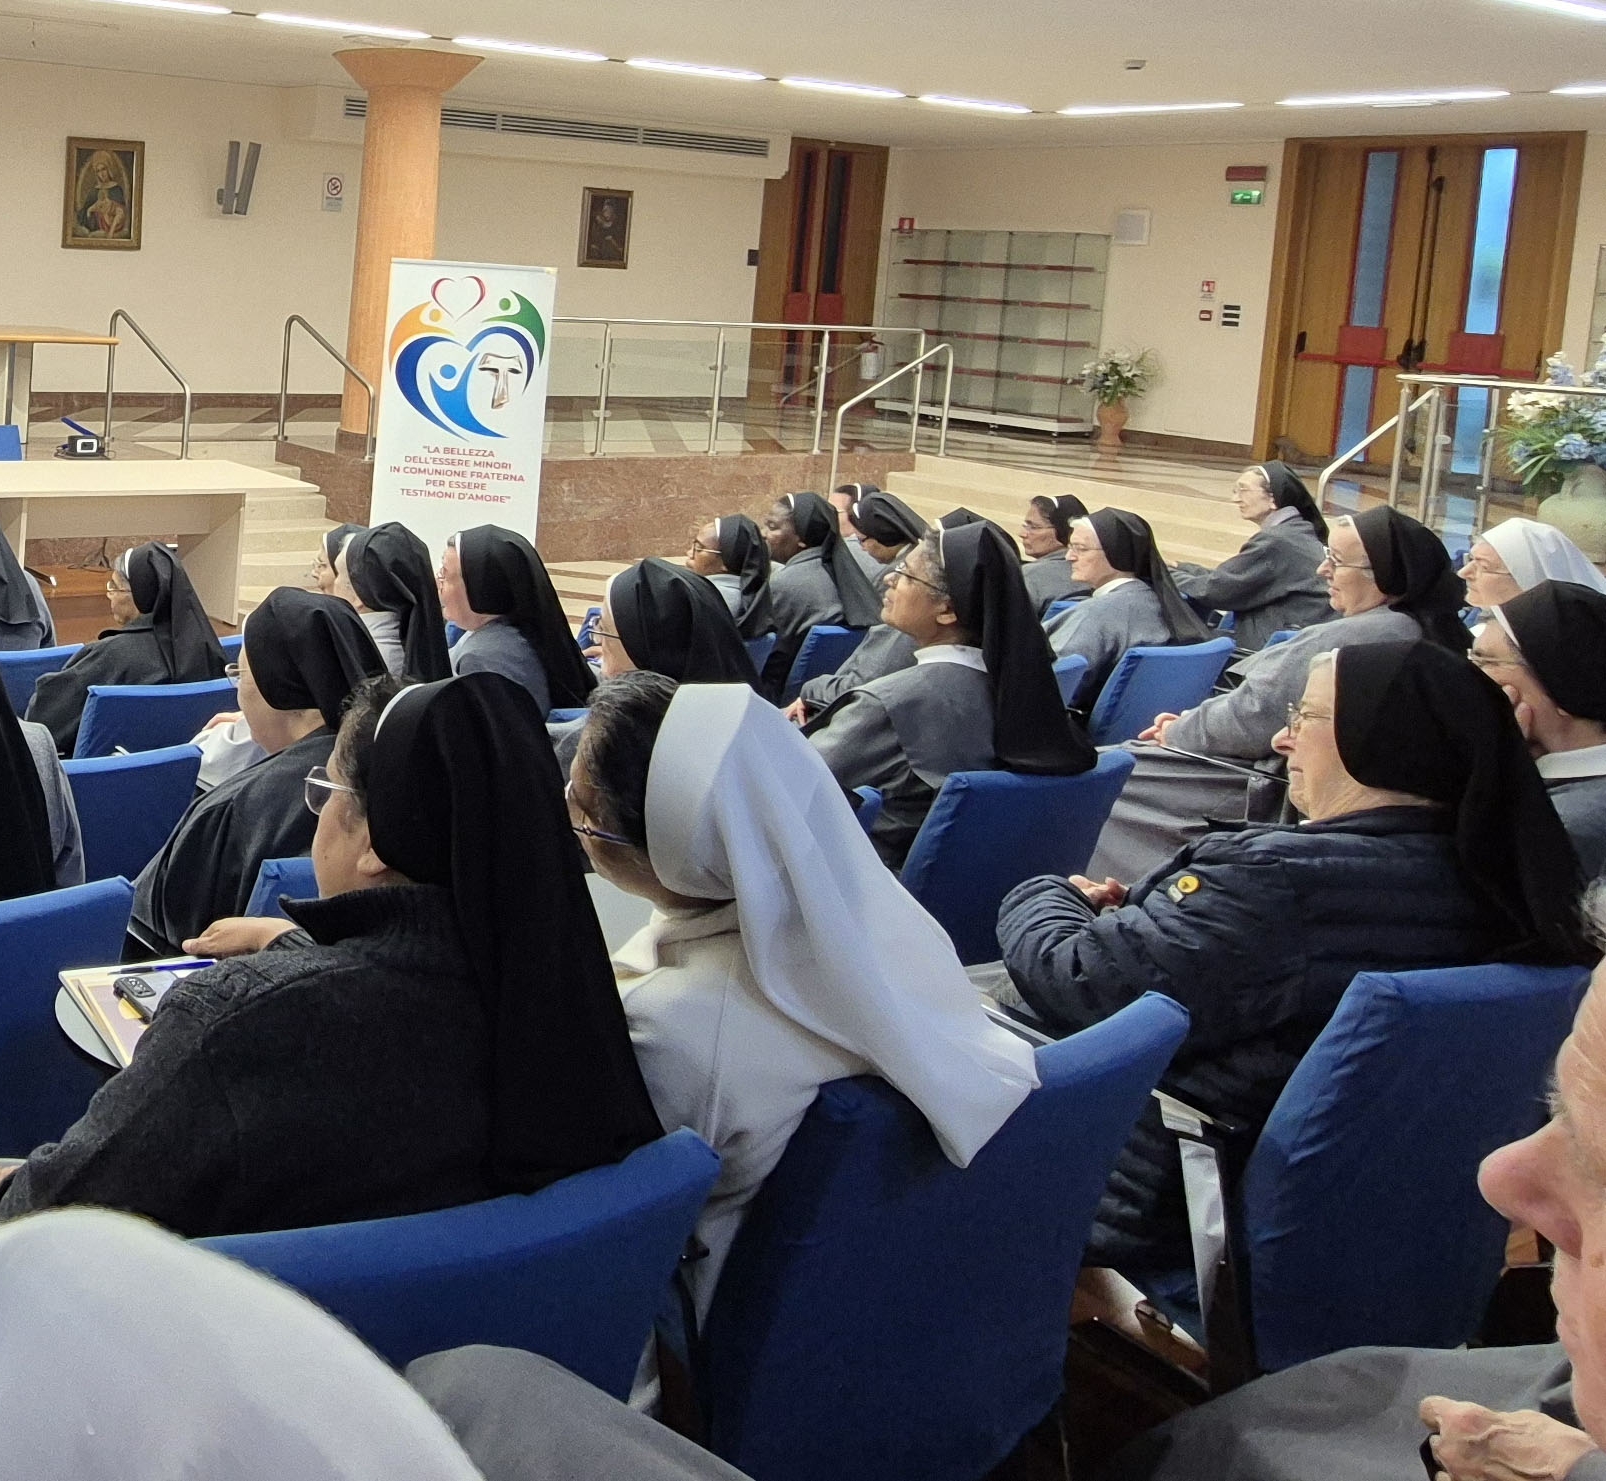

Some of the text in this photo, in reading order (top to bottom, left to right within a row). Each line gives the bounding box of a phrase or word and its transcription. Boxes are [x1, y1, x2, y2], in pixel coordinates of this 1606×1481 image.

[443, 447, 495, 458] BELLEZZA
[473, 460, 512, 470] MINORI
[389, 465, 525, 482] IN COMUNIONE FRATERNA
[425, 479, 487, 490] PER ESSERE
[400, 488, 455, 499] TESTIMONI
